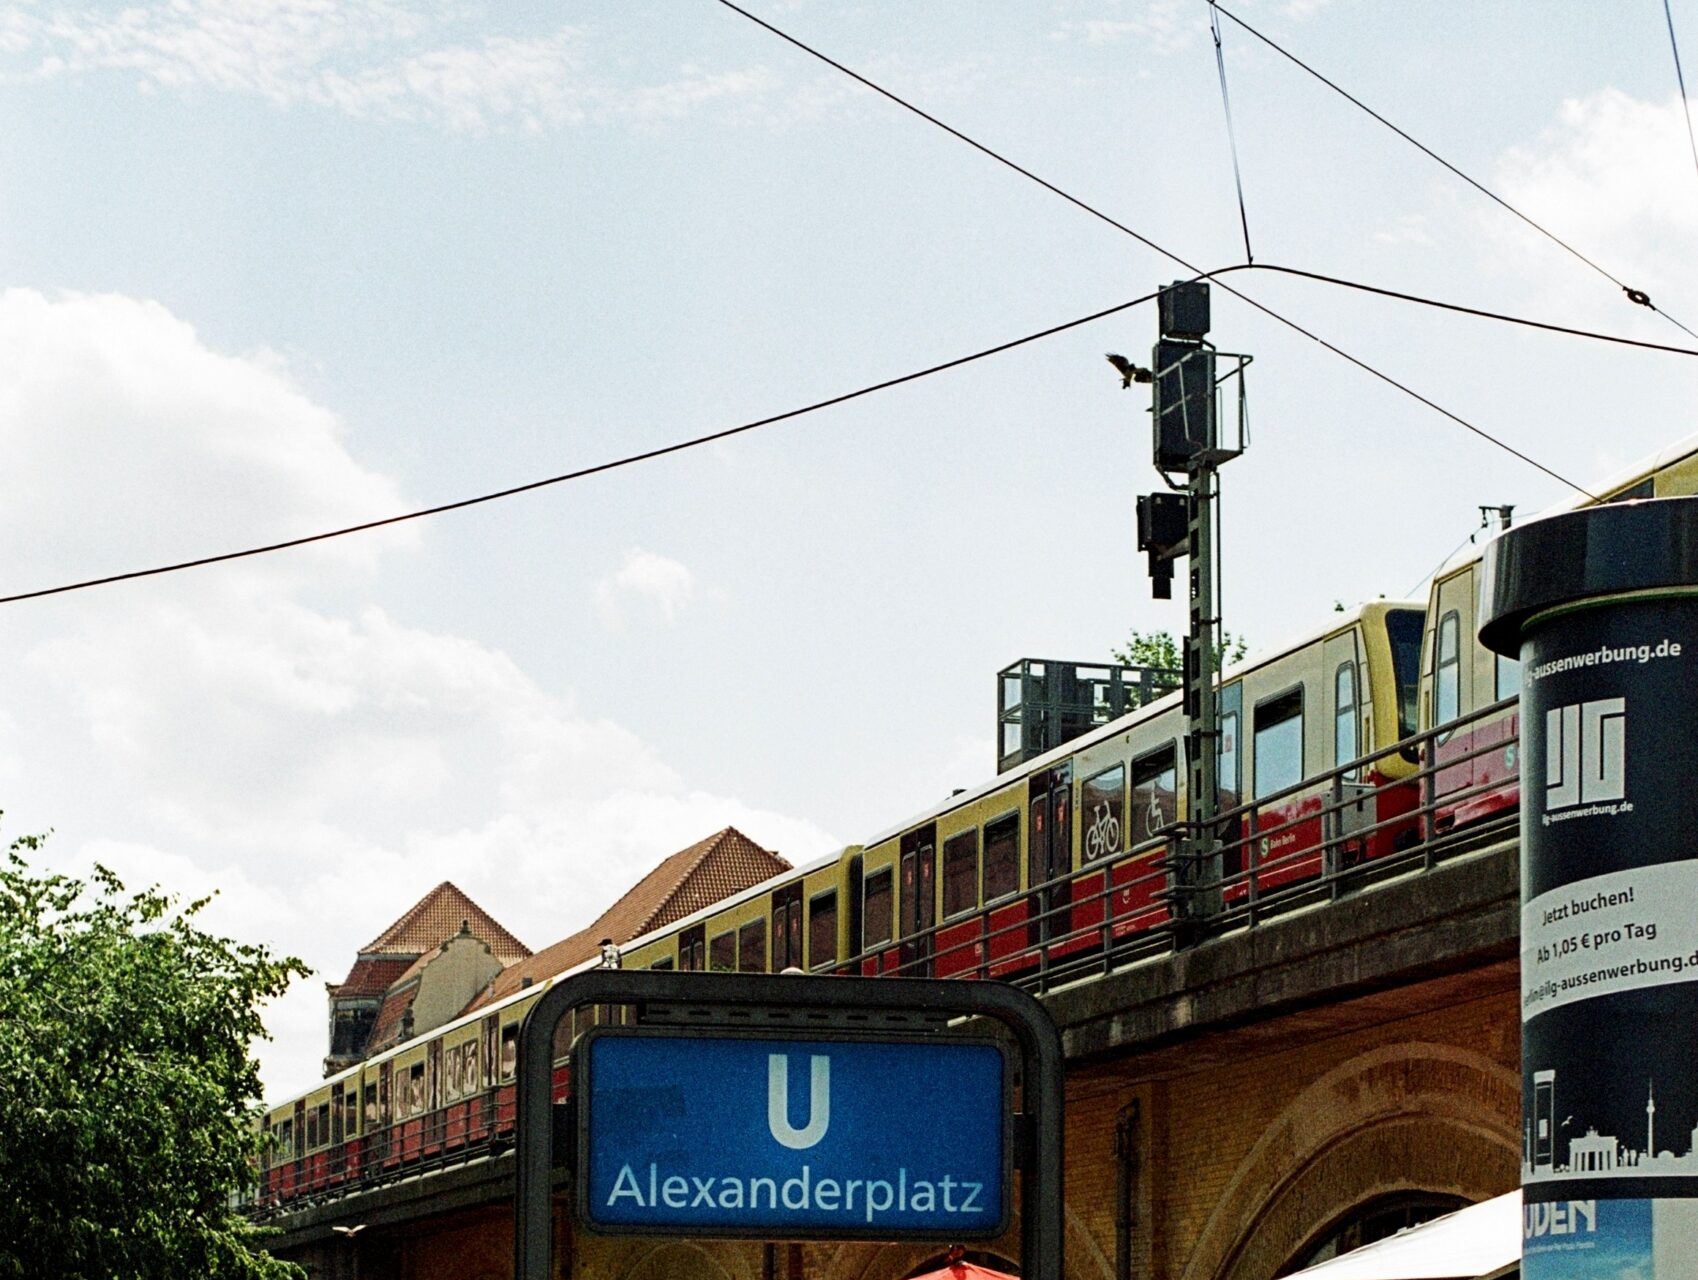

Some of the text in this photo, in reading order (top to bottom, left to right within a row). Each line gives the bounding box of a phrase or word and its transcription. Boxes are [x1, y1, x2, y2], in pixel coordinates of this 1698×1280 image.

[1542, 886, 1635, 926] Jetzt buchen!
[1537, 922, 1657, 965] Ab 1,05 € pro Tag
[767, 1054, 830, 1149] U
[606, 1162, 984, 1222] Alexanderplatz
